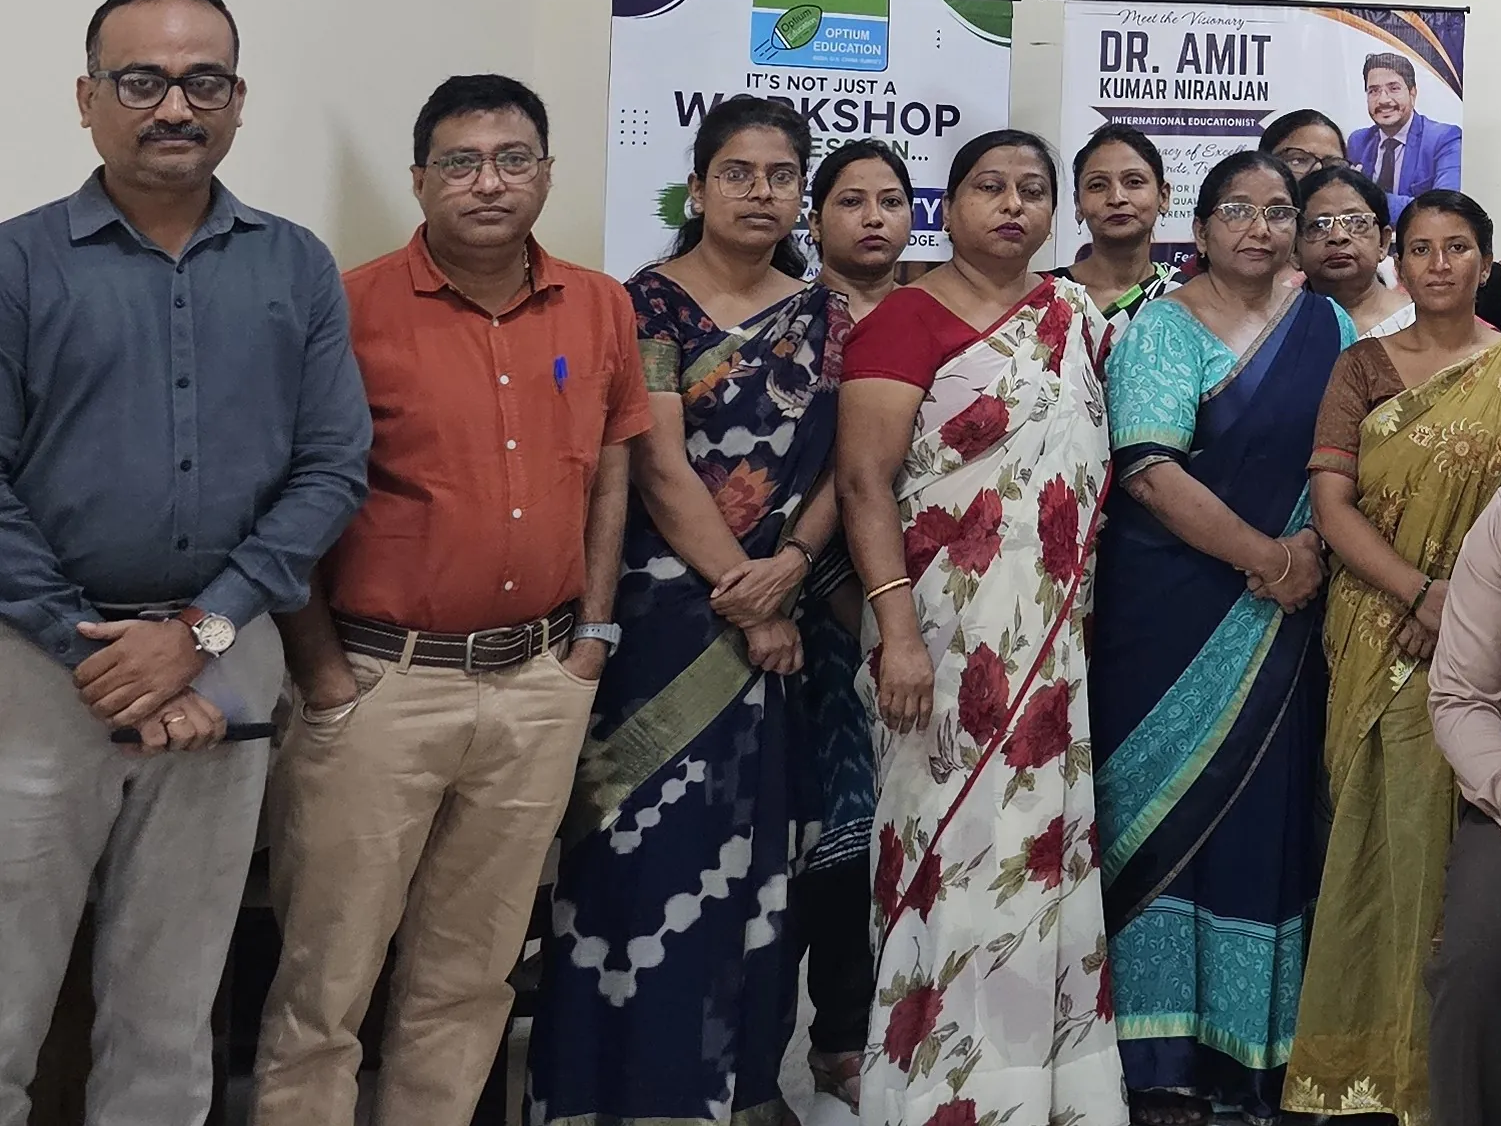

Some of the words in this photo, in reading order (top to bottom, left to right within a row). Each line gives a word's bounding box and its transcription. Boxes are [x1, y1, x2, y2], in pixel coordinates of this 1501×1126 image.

[781, 9, 813, 32] Optium
[1118, 9, 1157, 25] Meet
[1160, 11, 1179, 24] the
[1182, 11, 1246, 30] Visionary
[825, 28, 870, 41] OPTIUM
[813, 41, 881, 55] EDUCATION
[1100, 30, 1160, 74] DR.
[1176, 32, 1272, 76] AMIT
[746, 73, 780, 90] IT'S
[787, 76, 828, 92] NOT
[833, 78, 878, 94] JUST
[884, 81, 897, 95] A
[1100, 77, 1167, 100] KUMAR
[1174, 79, 1269, 102] NIRANJAN
[674, 91, 961, 137] WKSHOP
[1111, 115, 1186, 127] INTERNATIONAL
[1188, 117, 1256, 128] EDUCATIONIST
[1185, 143, 1201, 161] of
